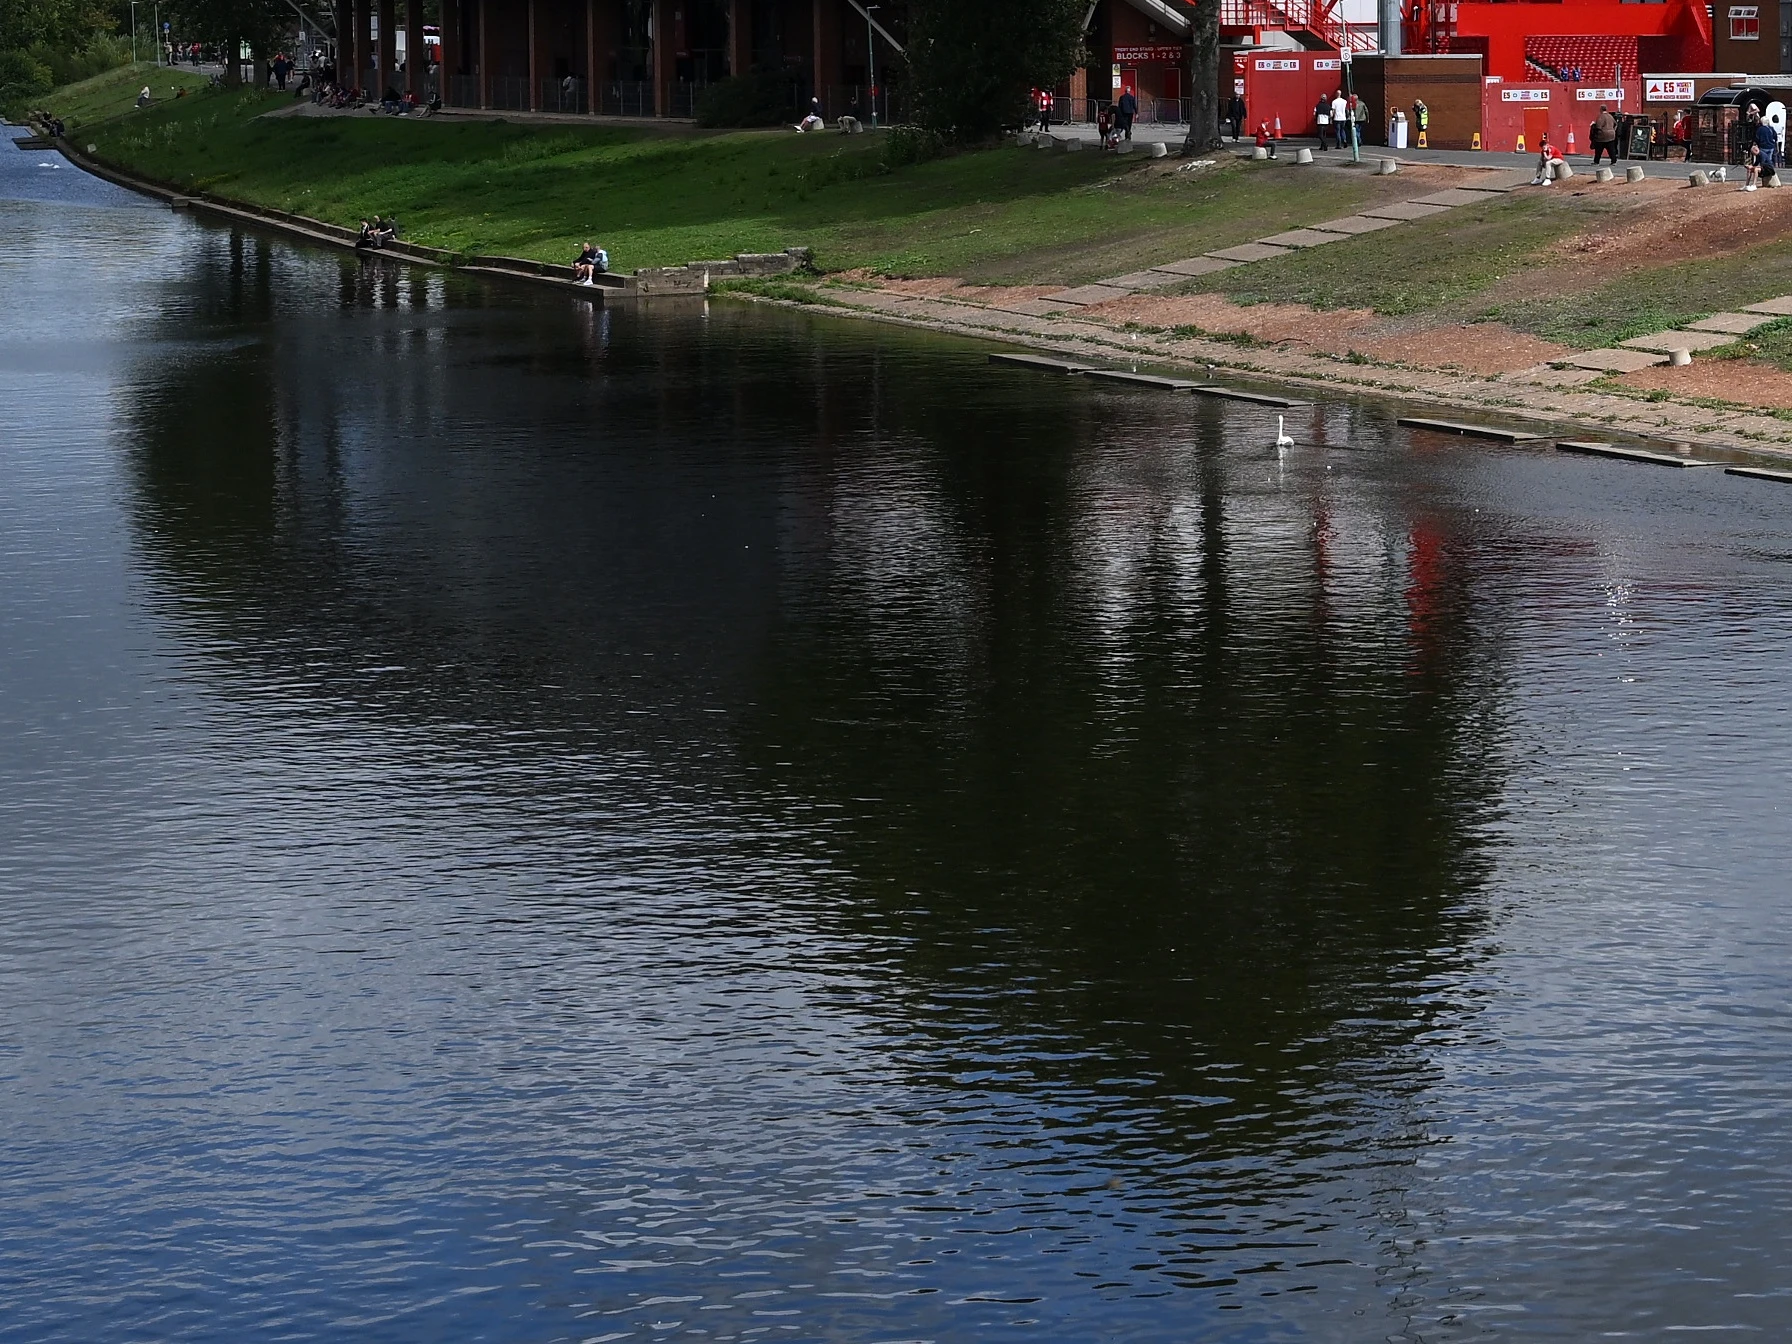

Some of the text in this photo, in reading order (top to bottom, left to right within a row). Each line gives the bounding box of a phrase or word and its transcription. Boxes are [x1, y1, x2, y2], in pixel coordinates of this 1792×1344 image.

[1116, 52, 1149, 60] BLOCKS
[1176, 51, 1181, 59] 3
[1663, 82, 1675, 93] E5
